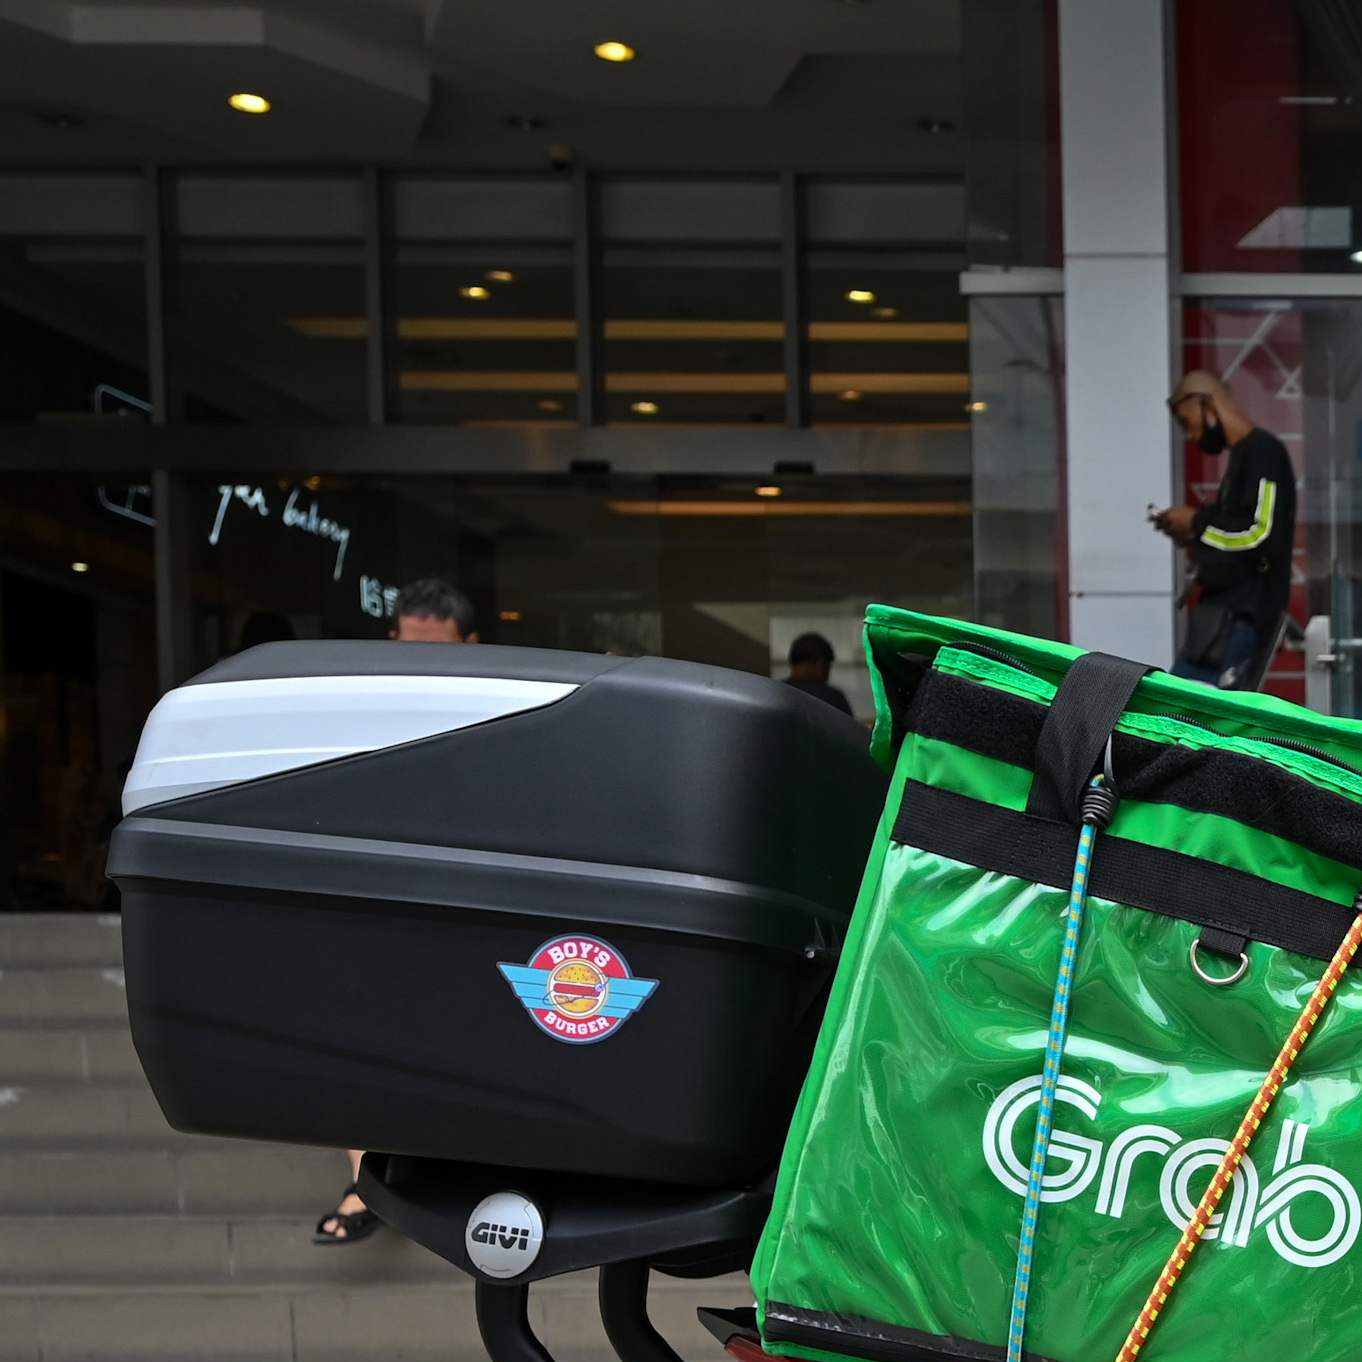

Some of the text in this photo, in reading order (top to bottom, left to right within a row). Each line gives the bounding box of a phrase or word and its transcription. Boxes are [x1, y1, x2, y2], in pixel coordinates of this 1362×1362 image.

[547, 941, 611, 968] BOY'S
[543, 1010, 610, 1035] BURGER
[982, 1074, 1362, 1268] Grab
[471, 1221, 530, 1251] GIVI
